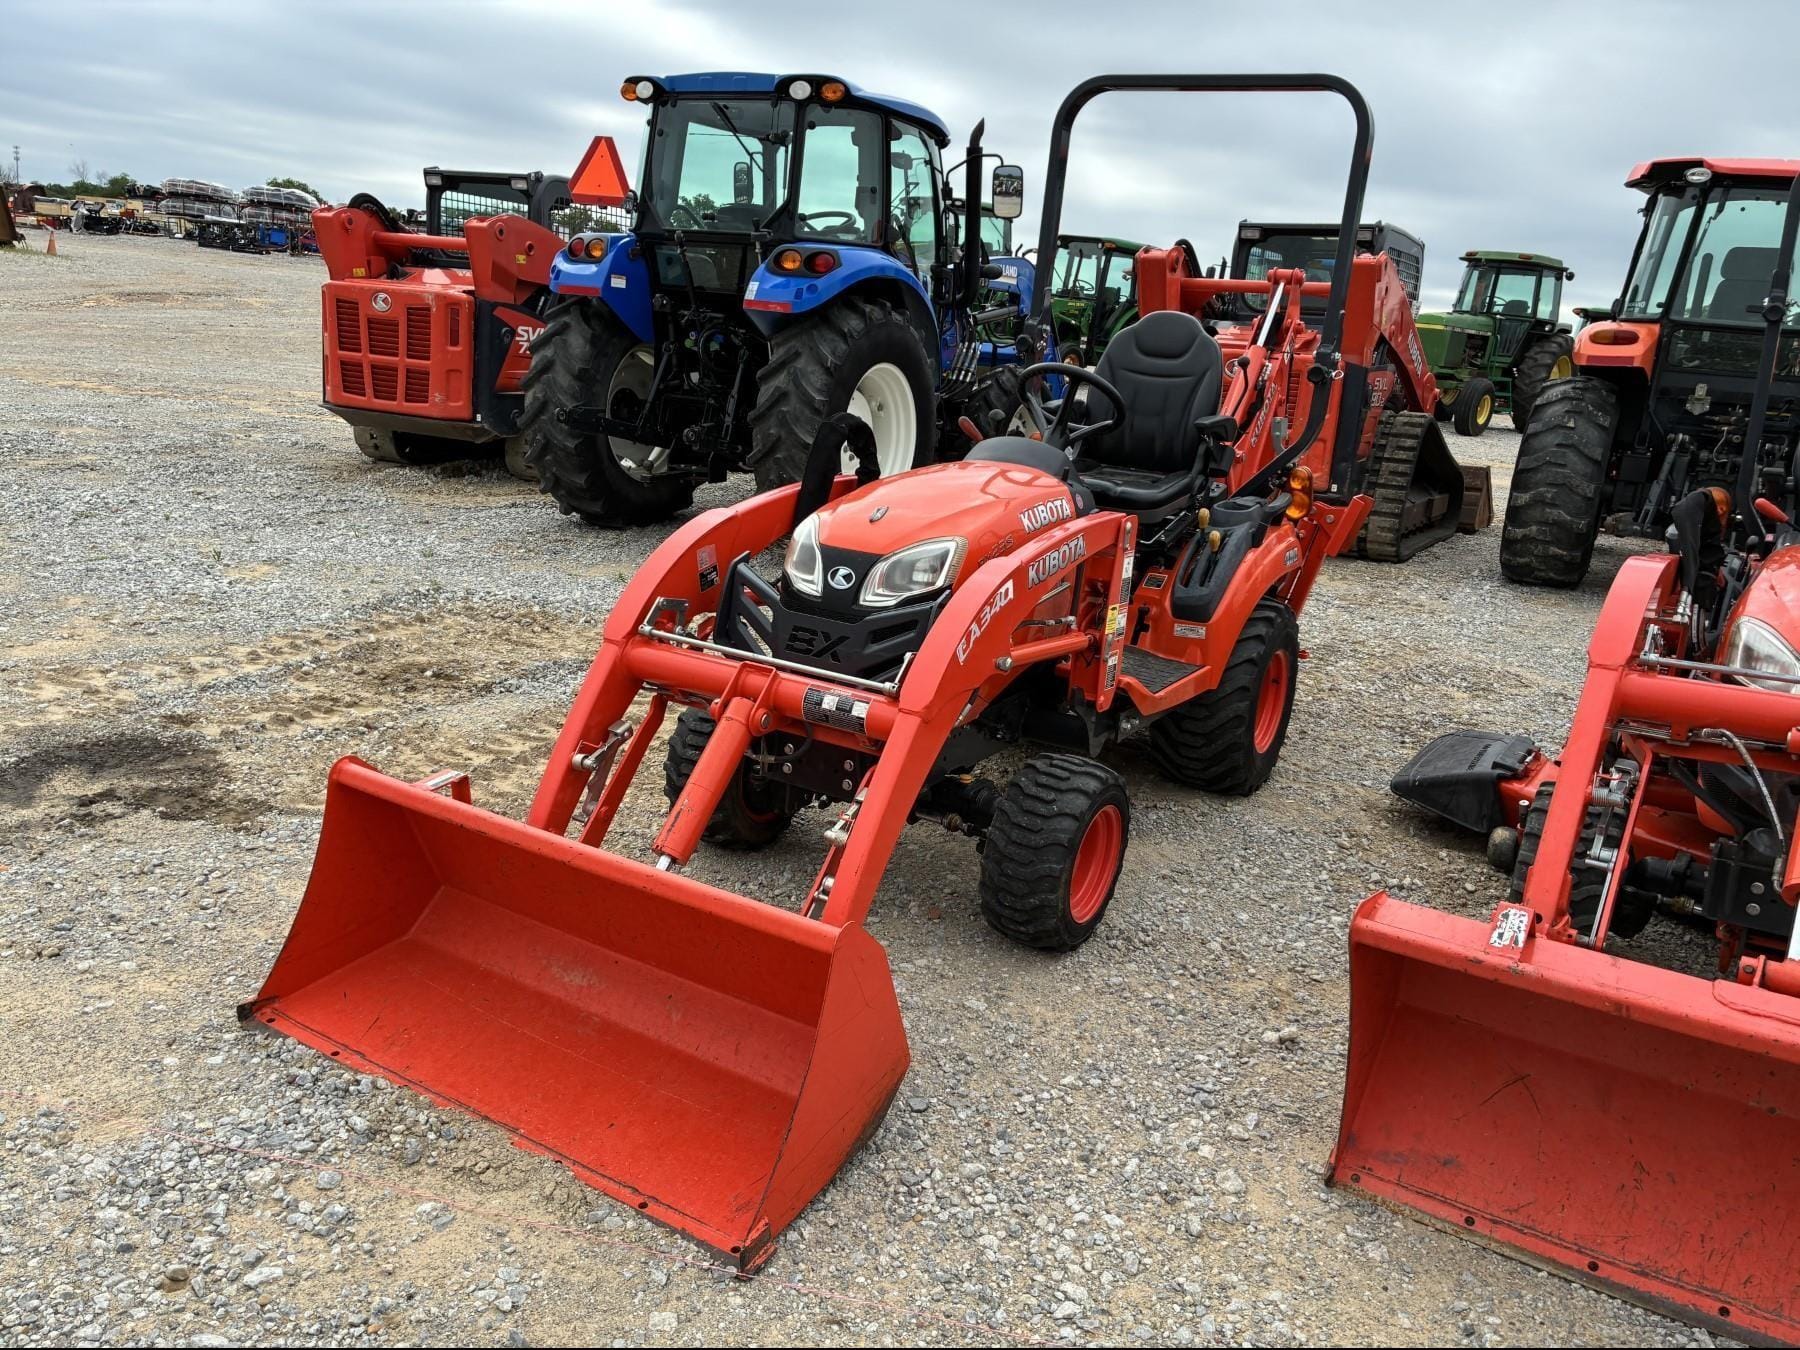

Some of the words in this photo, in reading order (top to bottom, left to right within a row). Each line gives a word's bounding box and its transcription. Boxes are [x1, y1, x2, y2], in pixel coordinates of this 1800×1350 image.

[1408, 329, 1422, 379] KUBOTA
[1251, 382, 1277, 448] KUBOTA
[1019, 497, 1072, 534] KUBOTA
[1028, 533, 1087, 589] KUBOTA
[784, 624, 850, 663] BX
